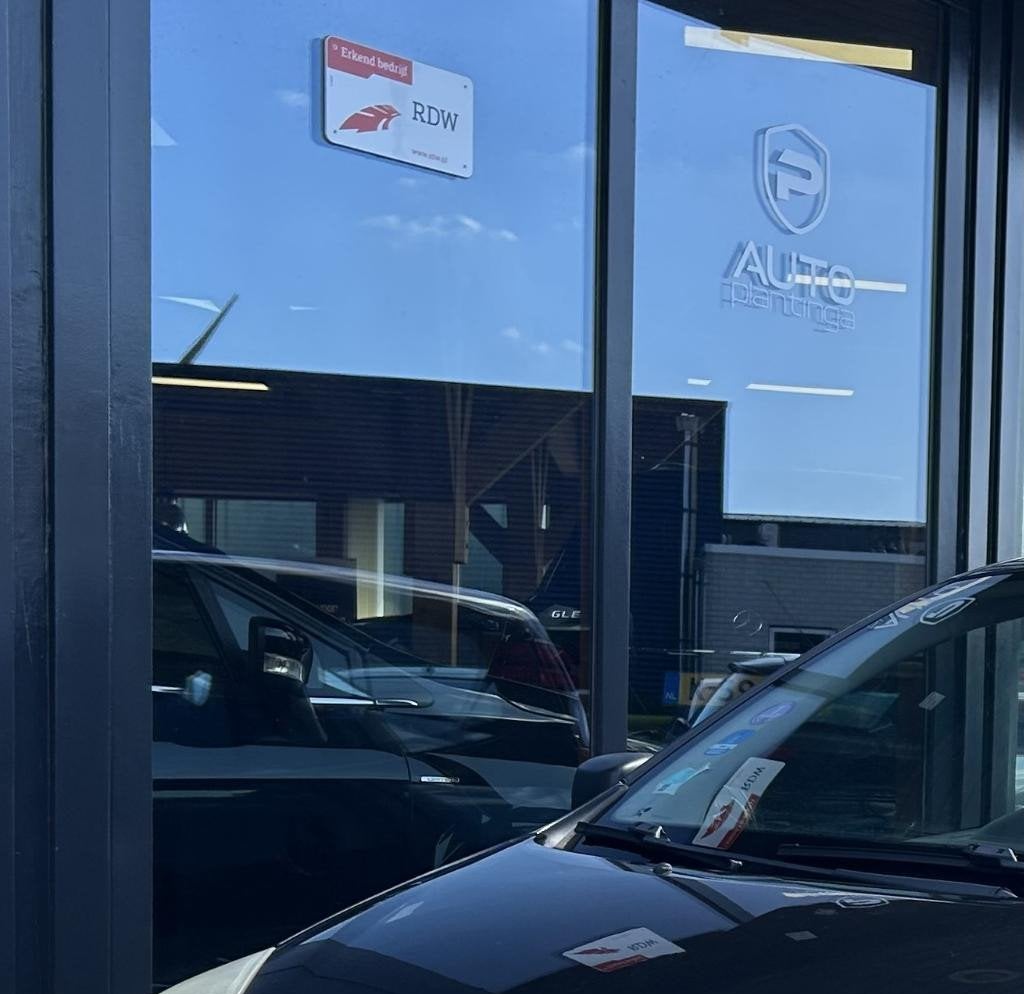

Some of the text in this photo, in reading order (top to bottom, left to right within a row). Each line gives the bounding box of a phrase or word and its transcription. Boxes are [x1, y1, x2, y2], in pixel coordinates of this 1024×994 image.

[340, 46, 409, 78] Erkend bedrijf
[412, 101, 460, 132] RDW
[732, 240, 856, 306] AUTO
[729, 280, 856, 334] plantinga
[551, 610, 583, 619] GLE
